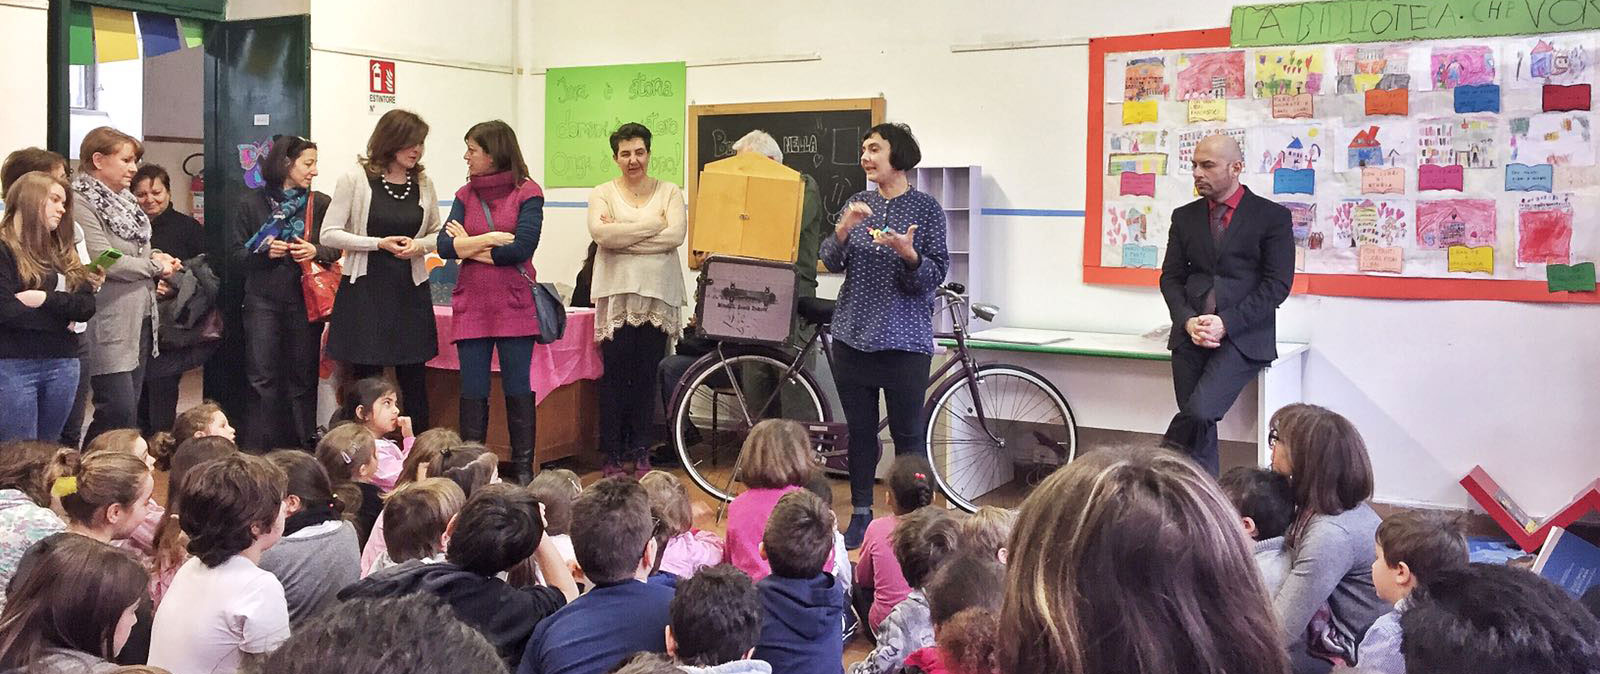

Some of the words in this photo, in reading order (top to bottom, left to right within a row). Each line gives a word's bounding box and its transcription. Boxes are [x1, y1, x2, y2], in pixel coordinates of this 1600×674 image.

[1240, 8, 1285, 41] LA
[369, 94, 396, 104] ESTINTORE
[783, 135, 817, 153] NELLA
